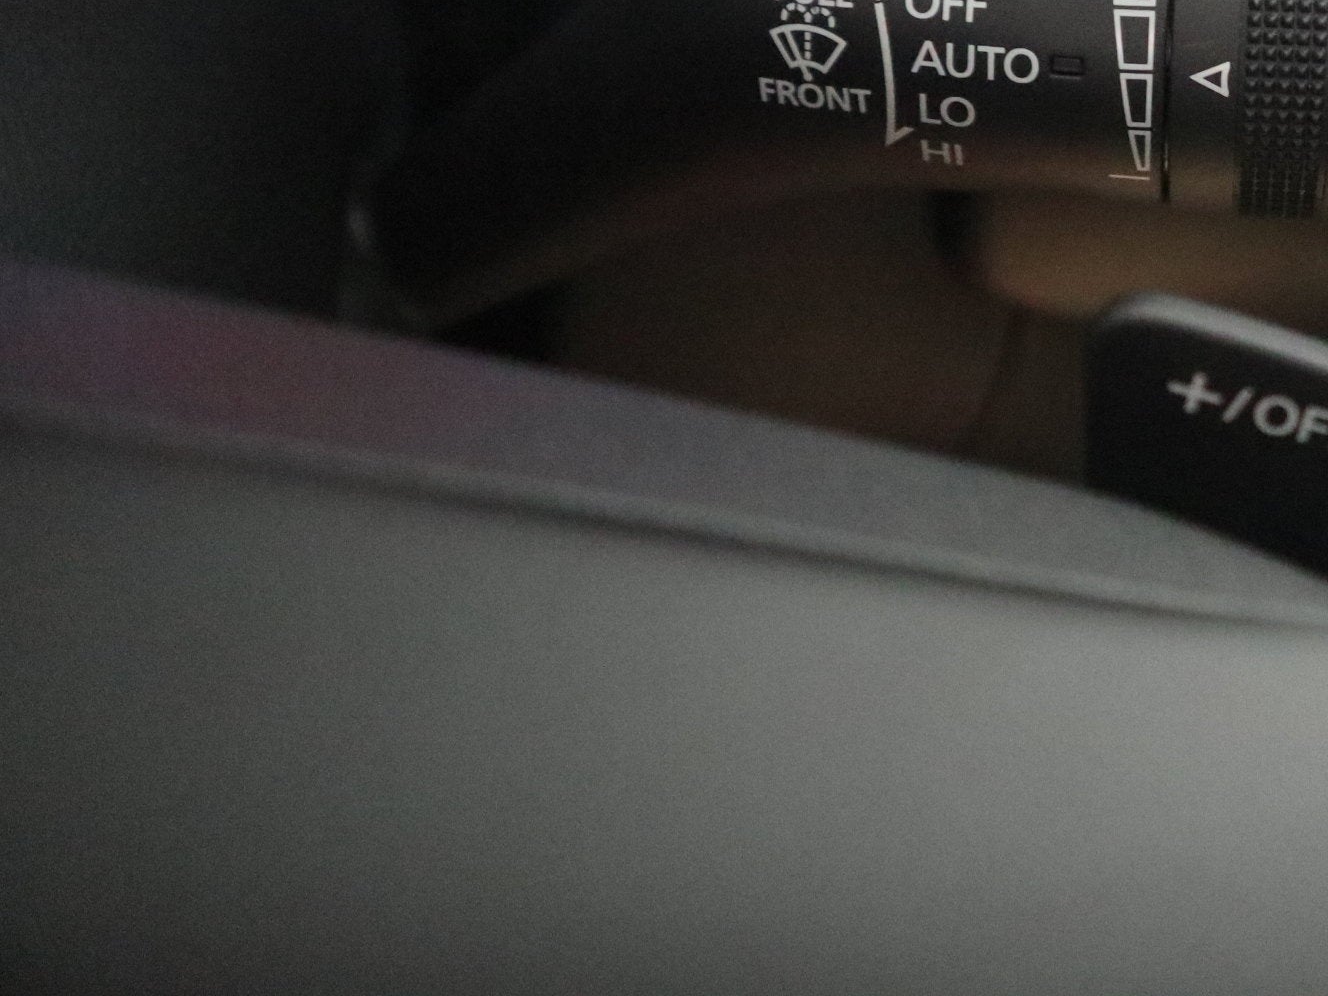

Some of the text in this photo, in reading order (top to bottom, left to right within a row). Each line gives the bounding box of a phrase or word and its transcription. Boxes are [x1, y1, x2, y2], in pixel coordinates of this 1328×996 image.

[911, 40, 1040, 84] AUTO
[758, 76, 872, 113] FRONT
[918, 92, 976, 128] LO
[920, 139, 965, 166] HI
